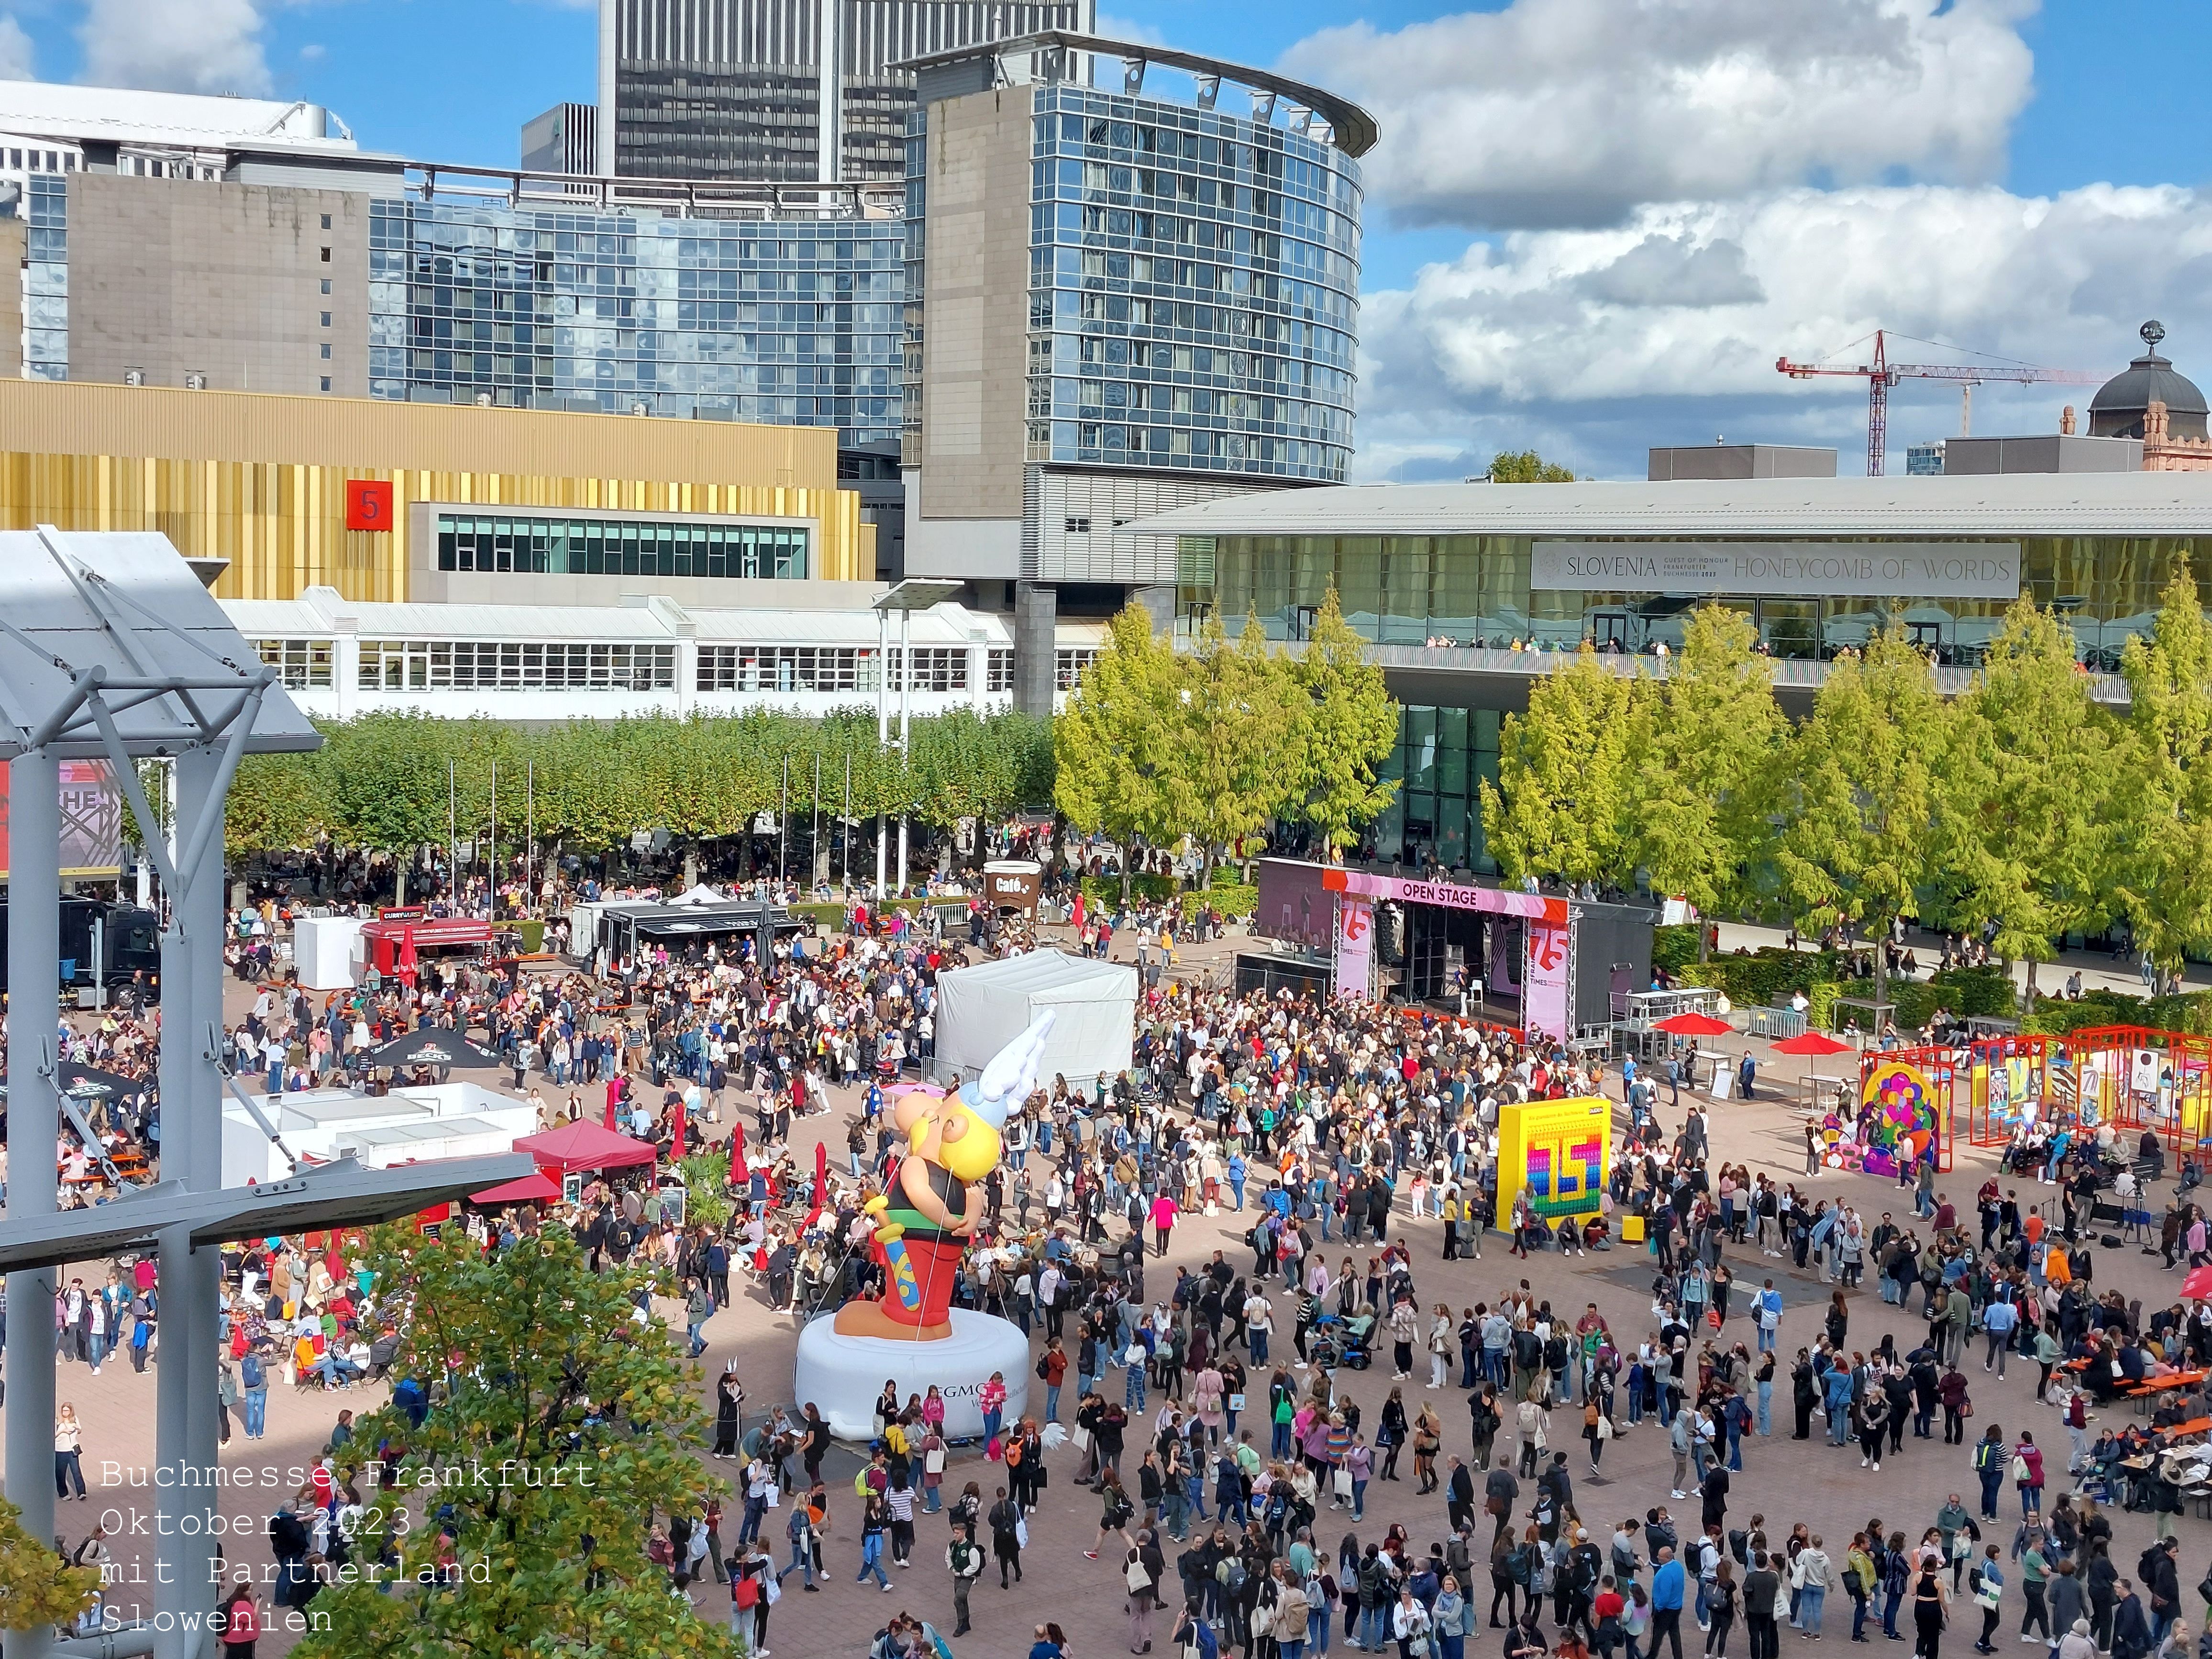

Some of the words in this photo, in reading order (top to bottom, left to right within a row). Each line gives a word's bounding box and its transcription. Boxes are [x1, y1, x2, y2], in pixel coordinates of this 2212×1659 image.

[362, 490, 378, 520] 5
[1567, 556, 1657, 577] SLOVENIA
[1734, 558, 1872, 579] HONEYCOMB
[1882, 559, 1913, 579] OF
[1923, 559, 2009, 581] WORDS
[996, 876, 1021, 893] Café
[1403, 883, 1435, 900] OPEN
[1438, 887, 1477, 906] STAGE
[1530, 927, 1568, 968] 75
[1530, 978, 1548, 986] TIMES
[1535, 1136, 1587, 1203] 75
